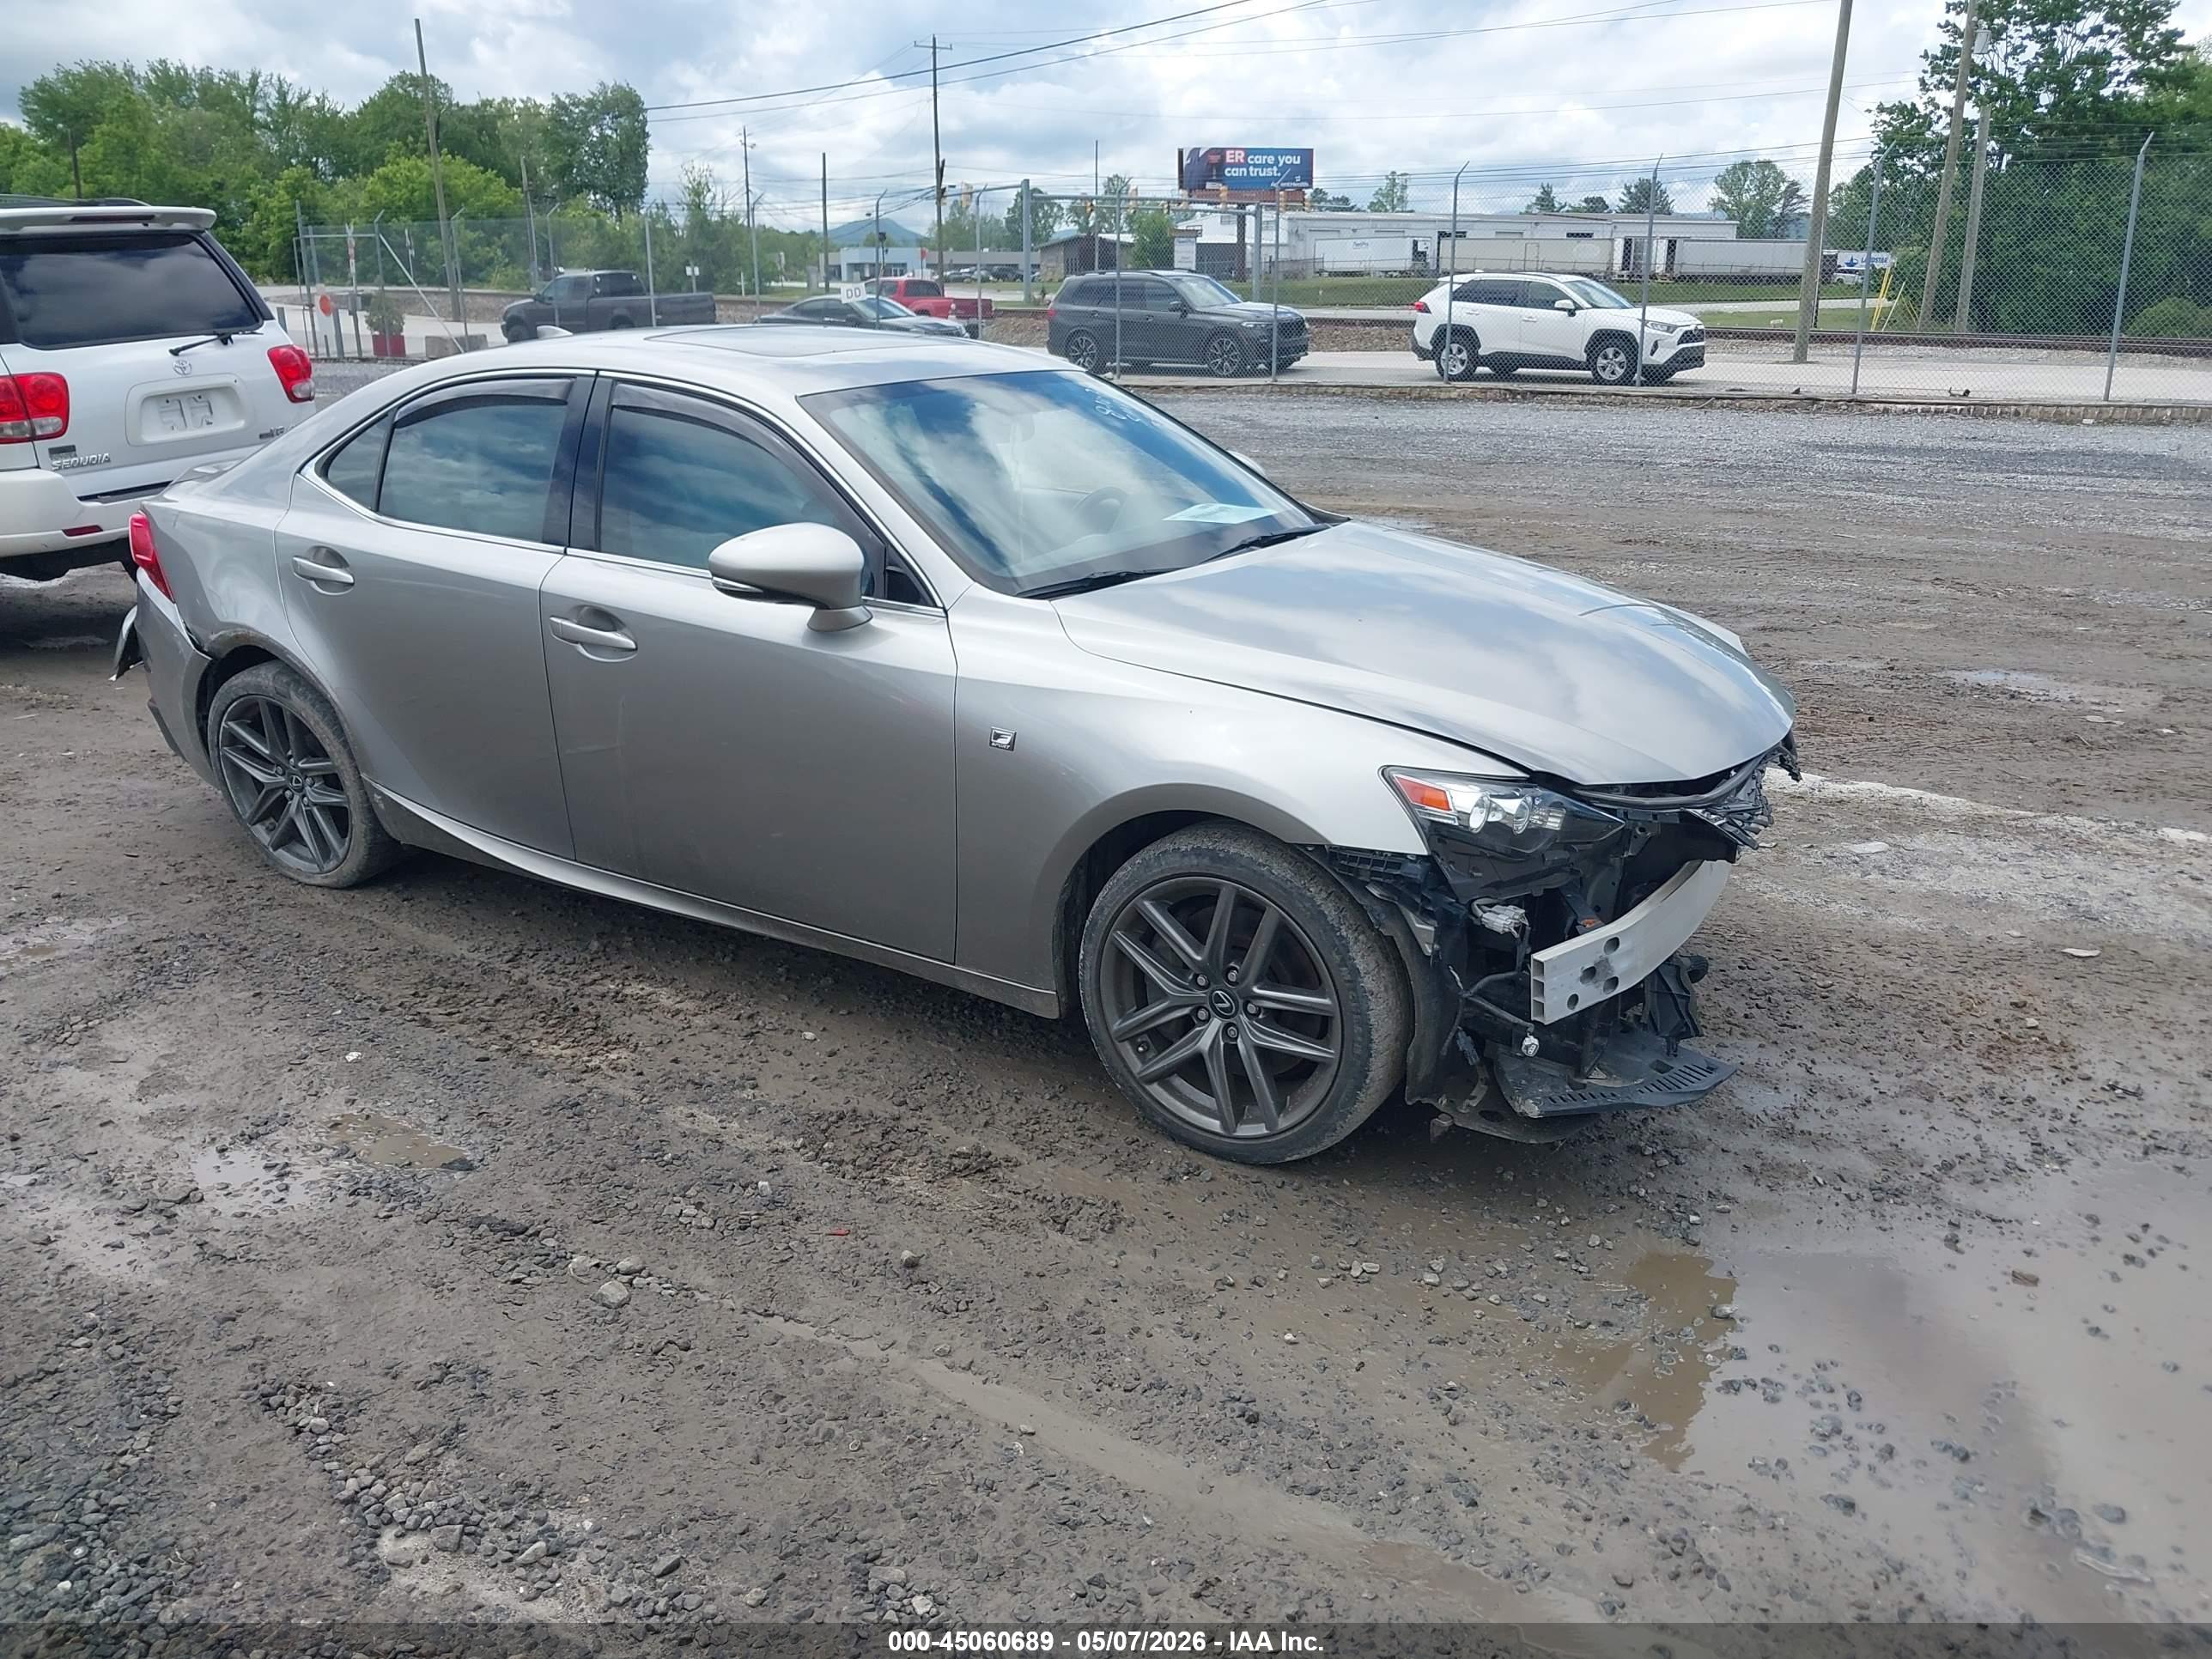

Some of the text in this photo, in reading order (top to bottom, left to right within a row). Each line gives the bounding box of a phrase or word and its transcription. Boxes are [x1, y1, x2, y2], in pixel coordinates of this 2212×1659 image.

[1225, 149, 1244, 163] ER
[1247, 154, 1275, 164] care
[1278, 154, 1301, 167] you
[1224, 166, 1281, 177] can trust.
[846, 287, 861, 299] DD
[52, 453, 111, 471] SEQUOIA
